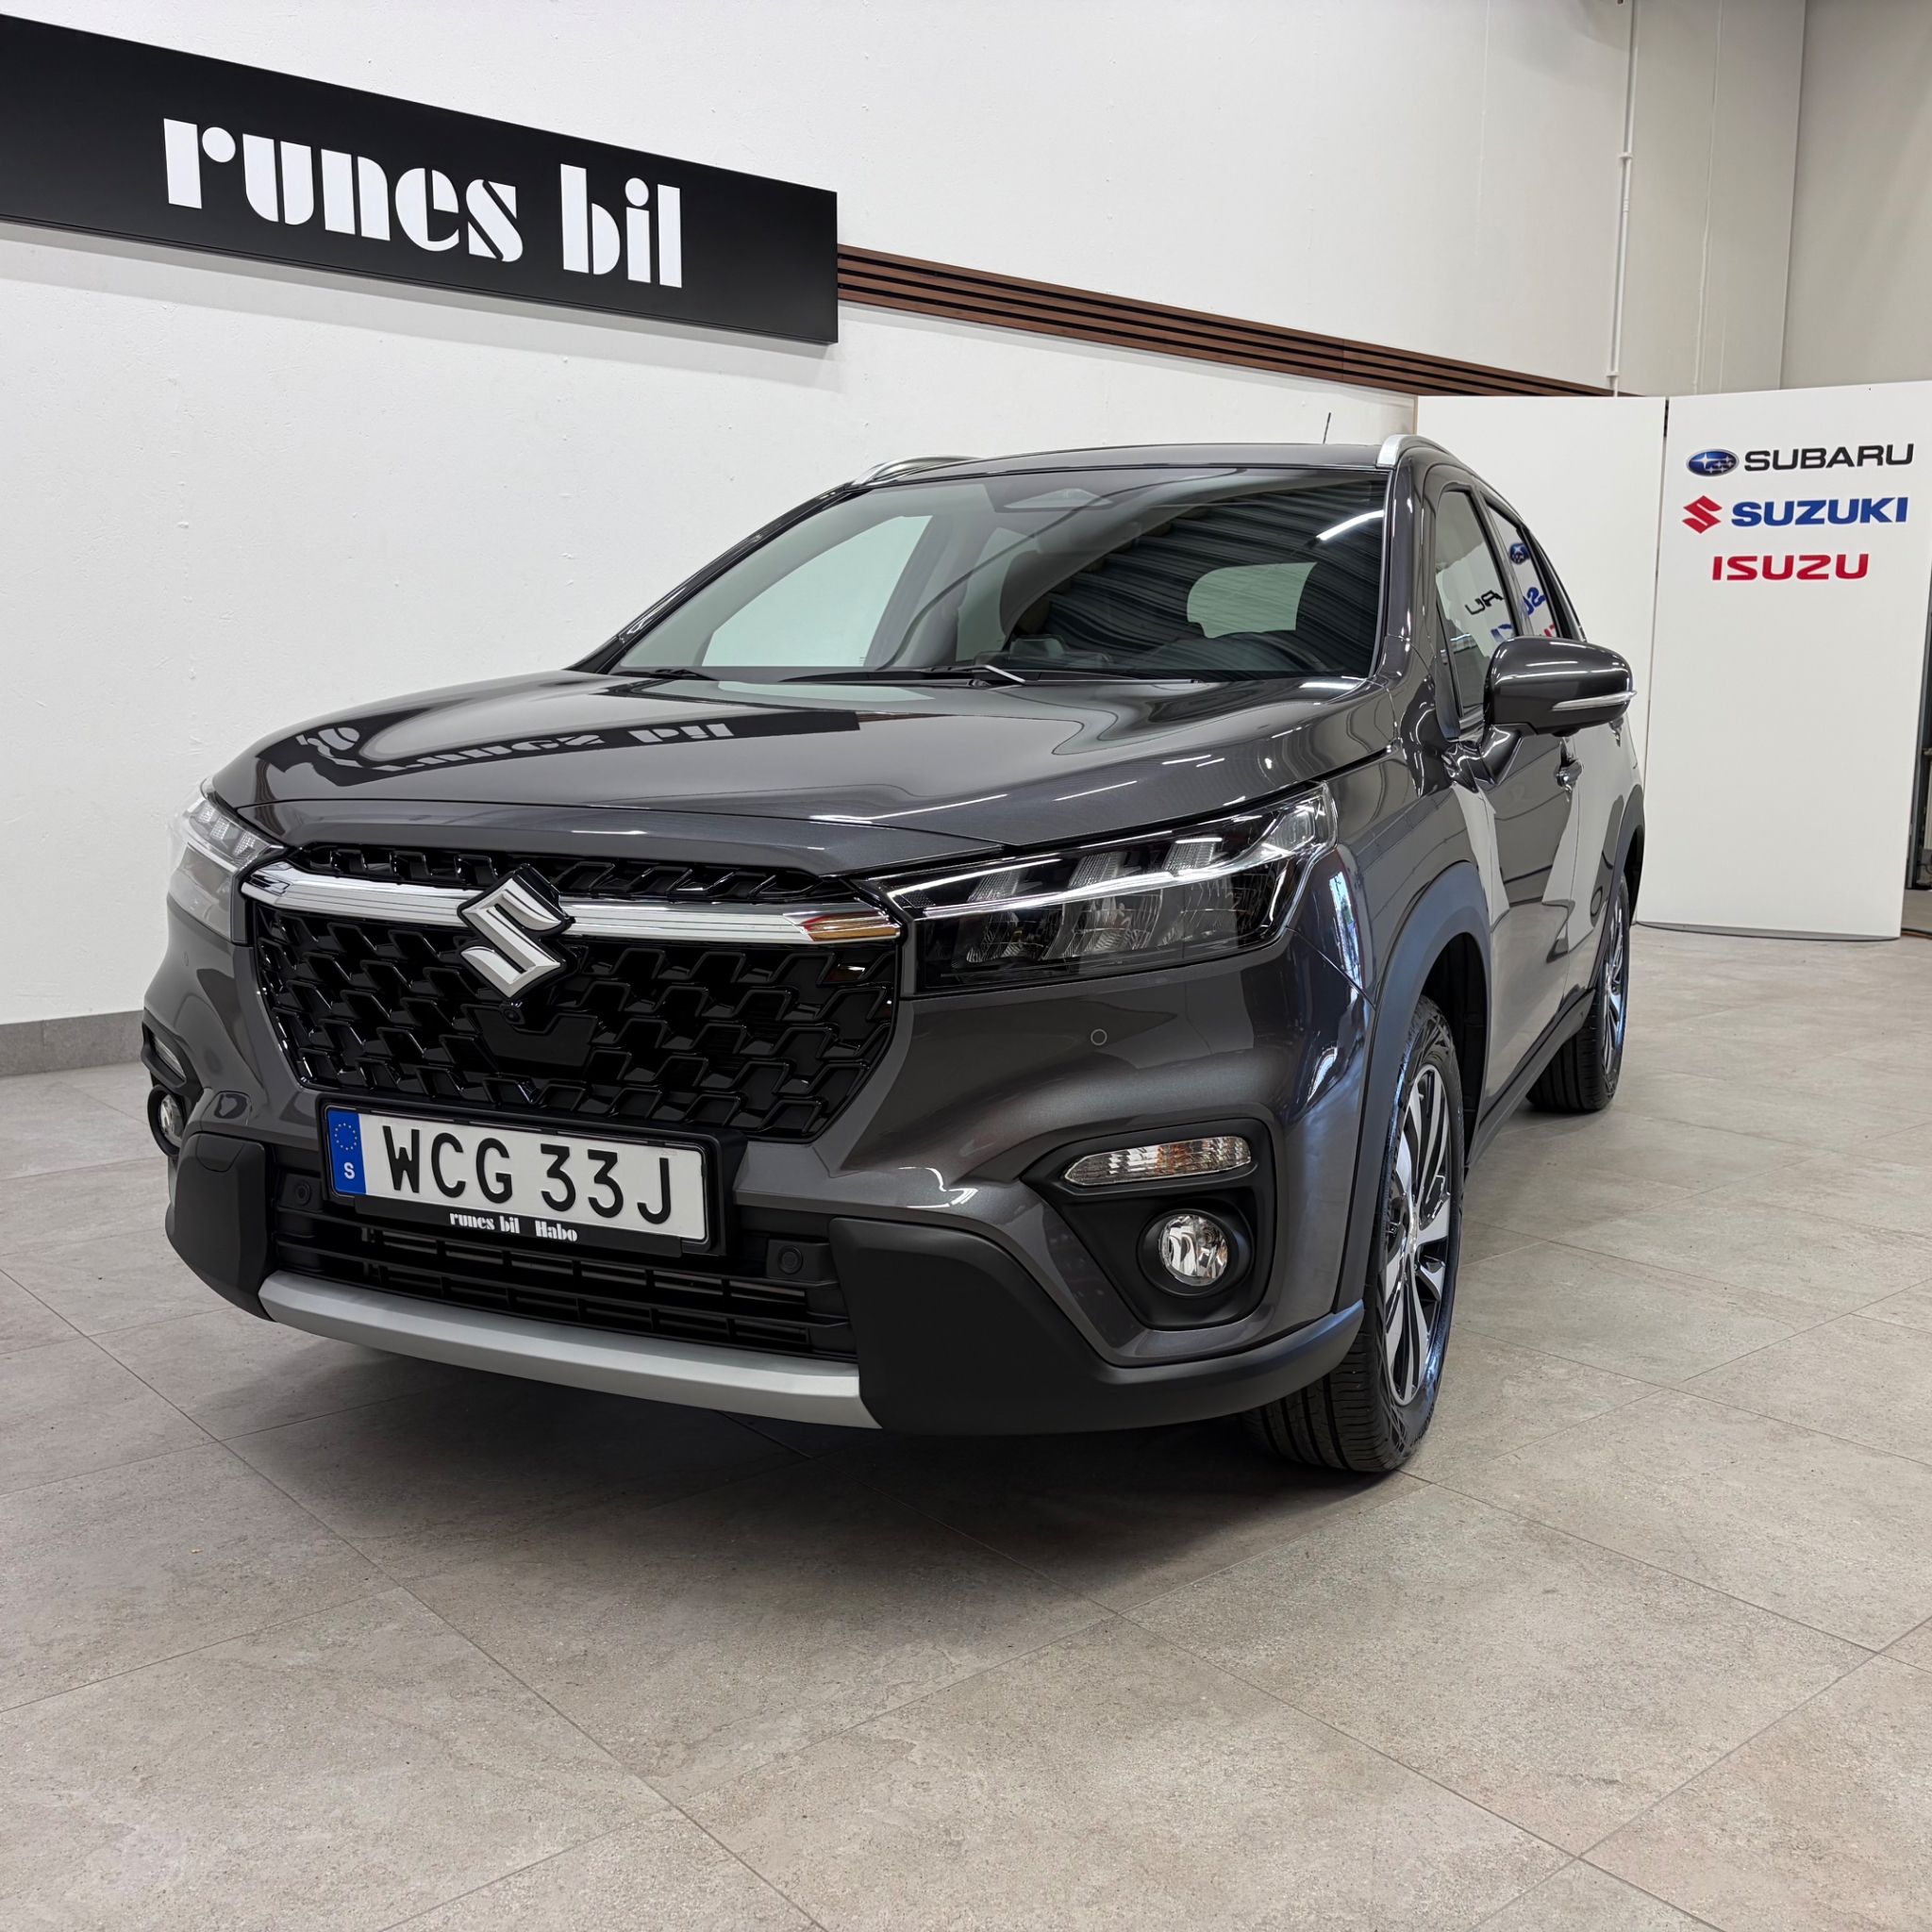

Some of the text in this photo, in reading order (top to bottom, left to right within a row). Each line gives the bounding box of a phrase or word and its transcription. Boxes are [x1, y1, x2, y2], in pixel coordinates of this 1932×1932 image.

[163, 118, 683, 289] runes bil
[1743, 442, 1915, 473] SUBARU
[1731, 496, 1909, 527] SUZUKI
[1711, 552, 1870, 582] ISUZU
[343, 1161, 357, 1180] S
[382, 1124, 672, 1225] WCG 33J
[449, 1212, 578, 1242] runes bil Habo
